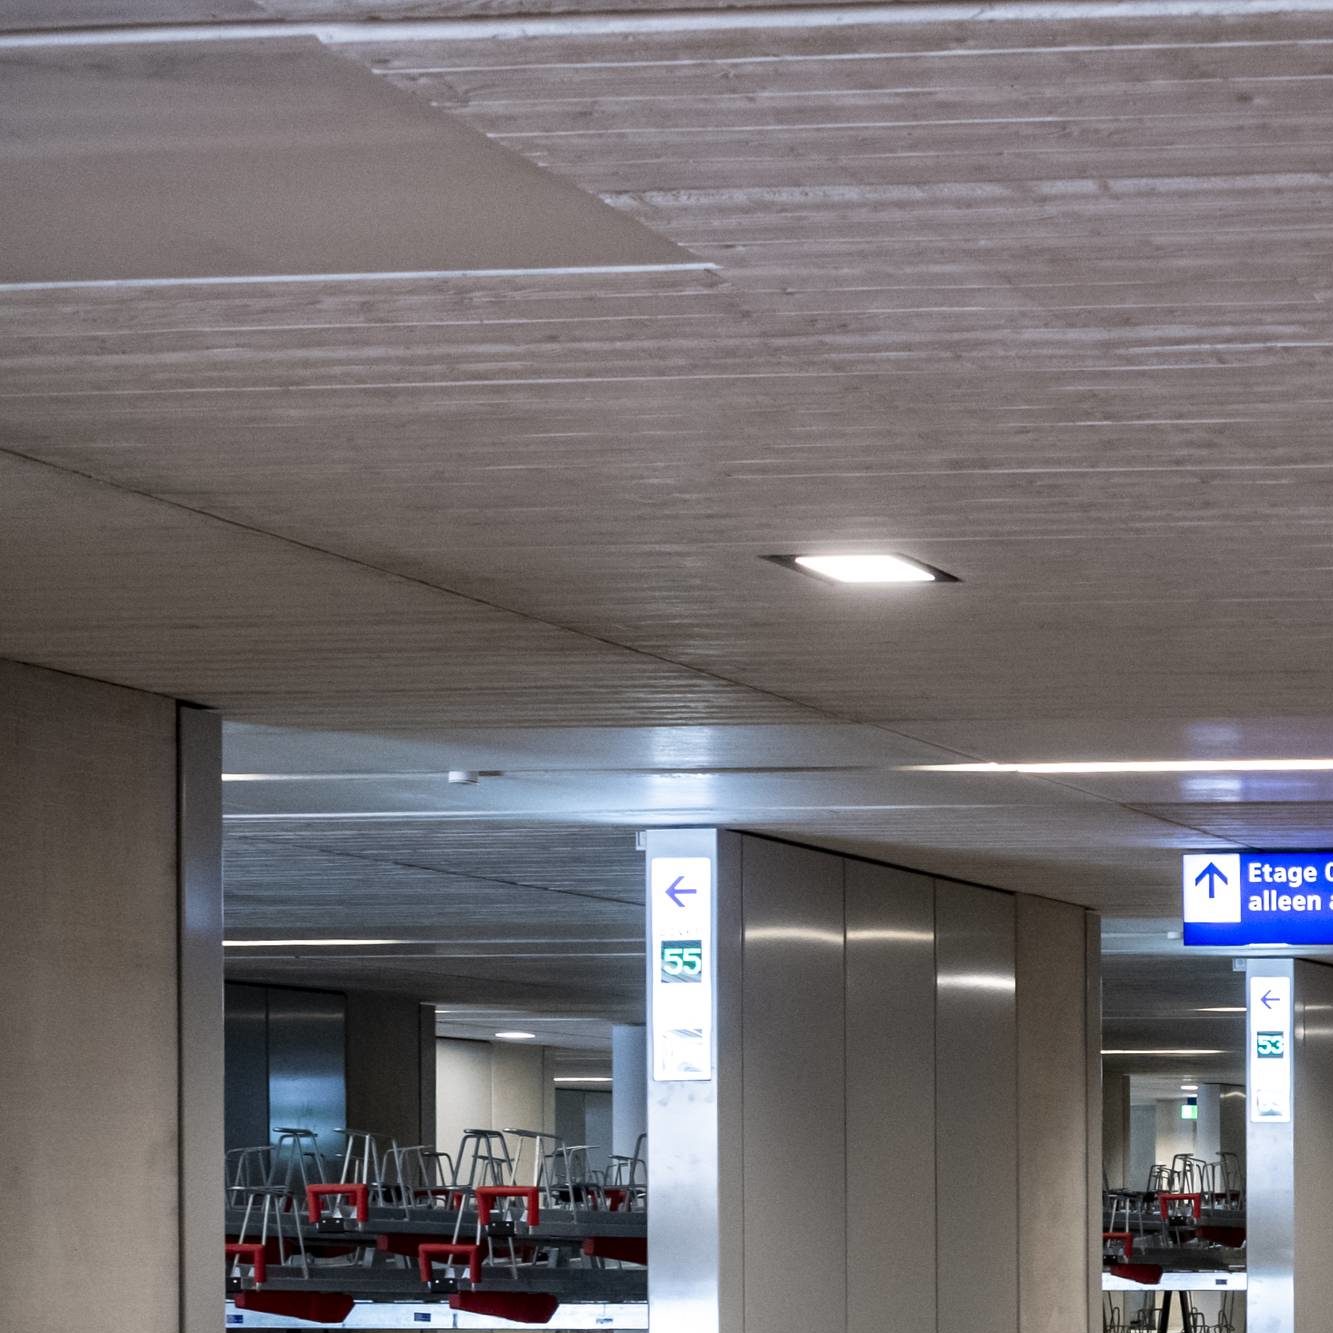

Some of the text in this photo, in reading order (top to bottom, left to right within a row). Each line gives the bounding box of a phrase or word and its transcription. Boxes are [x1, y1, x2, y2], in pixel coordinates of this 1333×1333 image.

[1248, 862, 1318, 888] Etage
[1248, 890, 1322, 911] alleen
[663, 947, 702, 976] 55
[1257, 1034, 1284, 1055] 53
